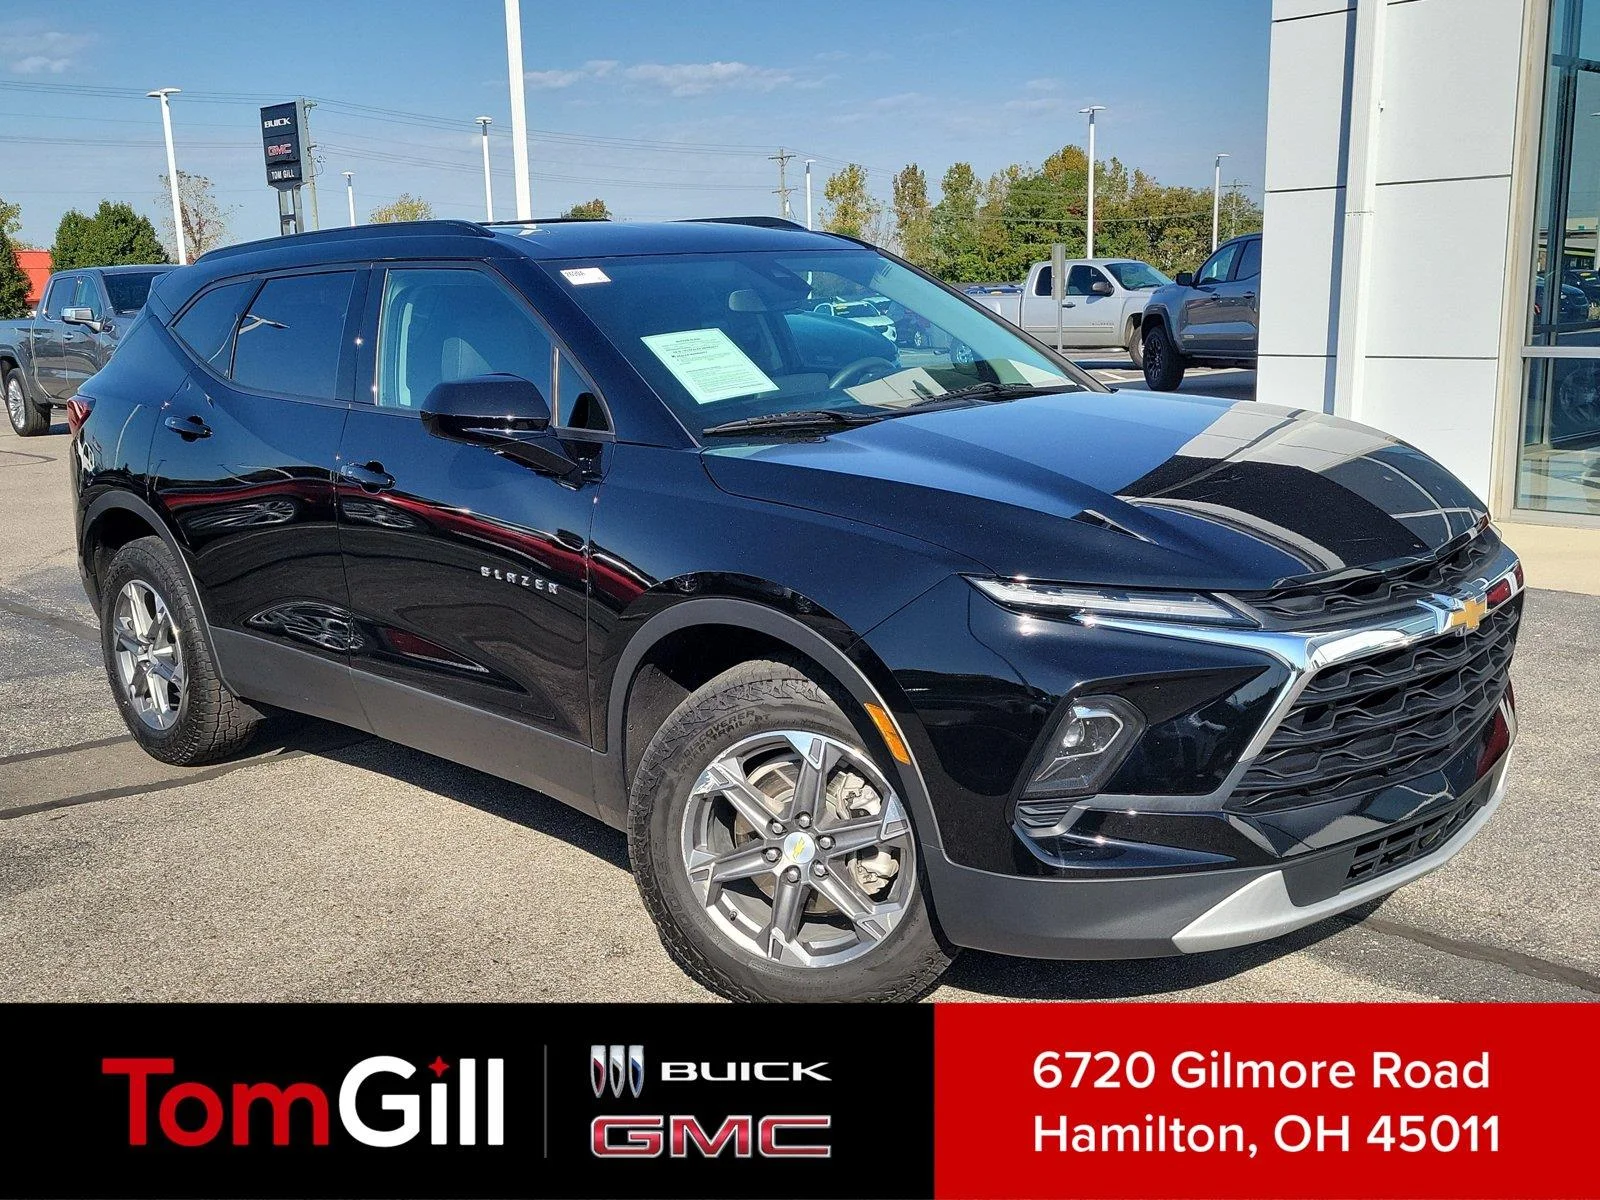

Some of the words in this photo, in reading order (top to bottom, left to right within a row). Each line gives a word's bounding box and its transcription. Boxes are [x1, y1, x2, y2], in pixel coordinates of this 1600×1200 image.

[264, 118, 291, 128] BUICK
[268, 144, 291, 156] GMC
[271, 171, 282, 179] TOM
[283, 169, 294, 178] GILL
[480, 565, 560, 595] BLAZER
[682, 709, 756, 758] DISCOVERER
